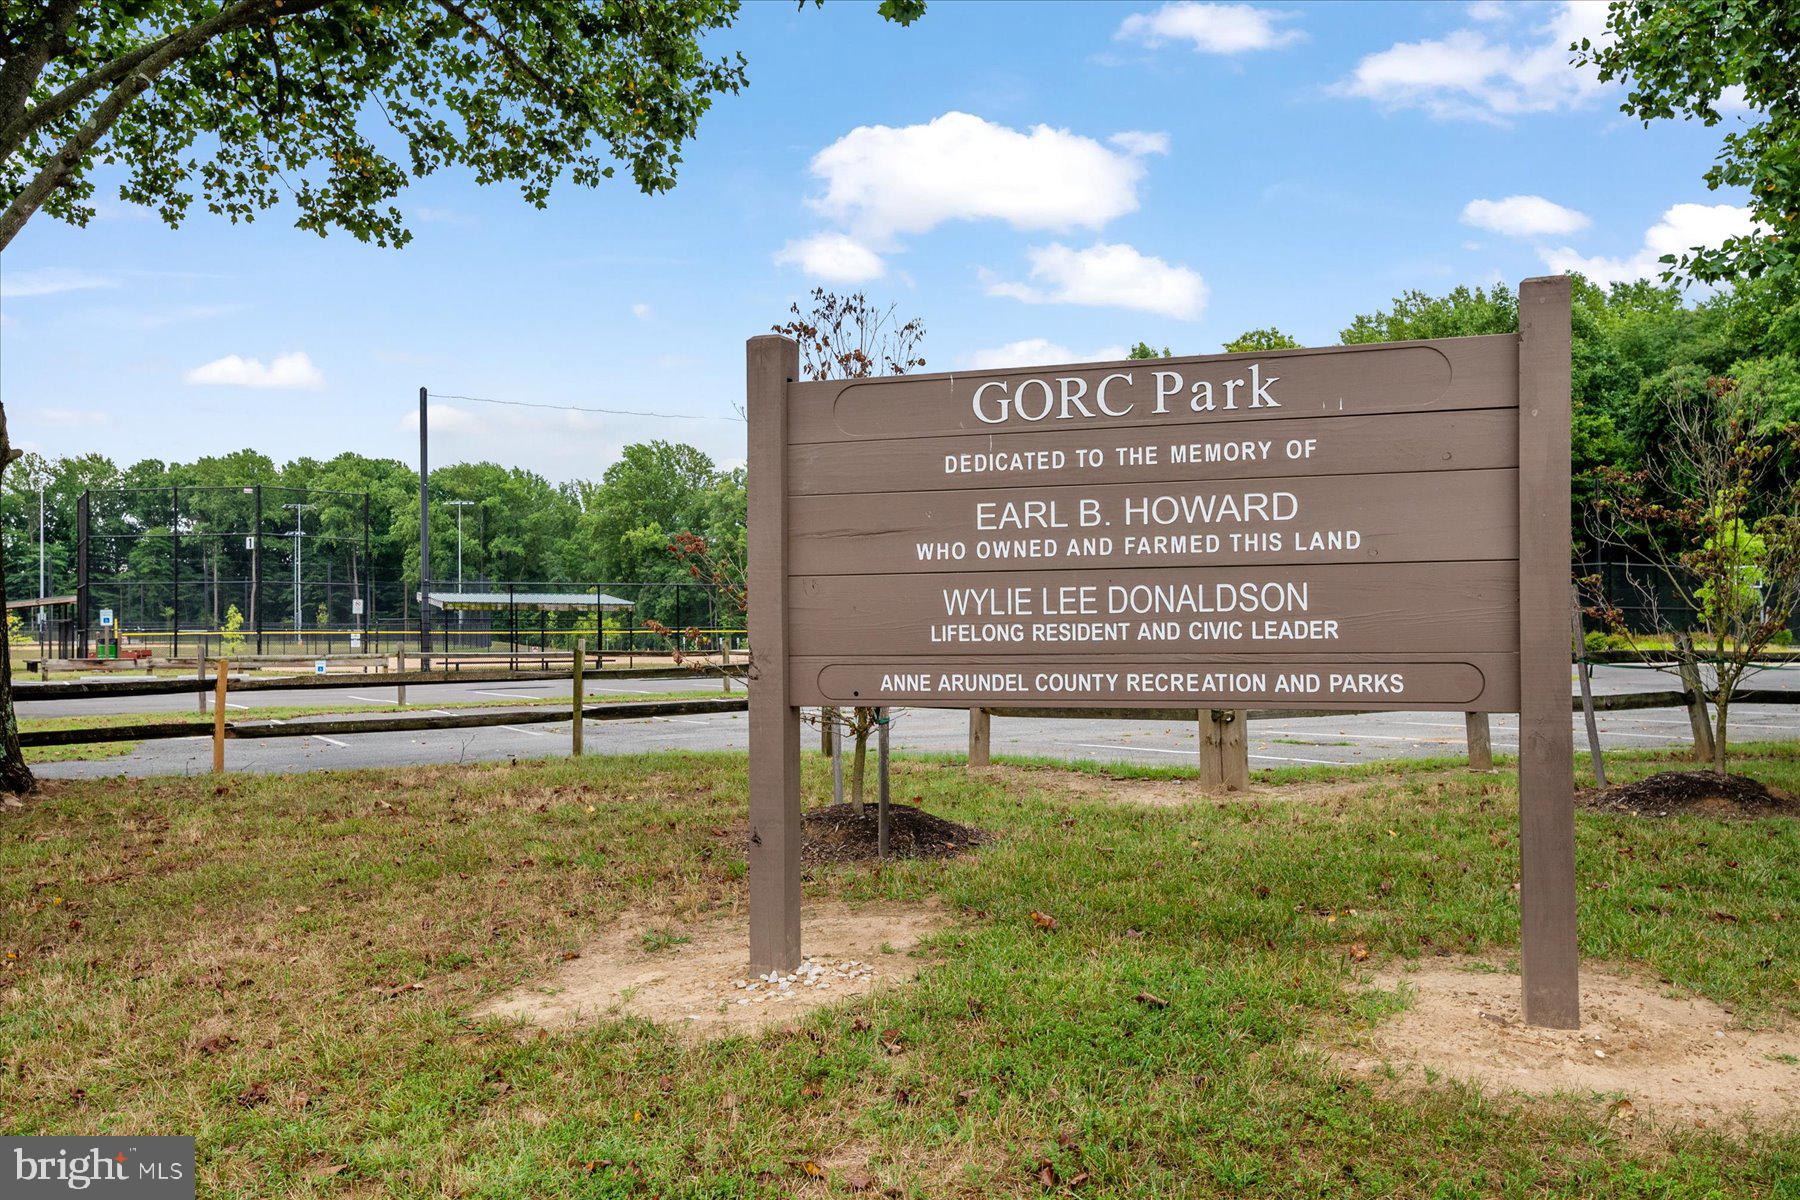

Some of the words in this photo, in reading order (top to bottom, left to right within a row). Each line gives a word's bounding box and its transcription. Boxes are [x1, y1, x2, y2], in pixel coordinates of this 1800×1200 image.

[972, 372, 1134, 424] GORC
[1151, 363, 1282, 414] Park
[944, 451, 1066, 474] DEDICATED
[1075, 449, 1104, 468] TO
[1115, 446, 1158, 466] THE
[1170, 441, 1272, 464] MEMORY
[1285, 438, 1317, 460] OF
[976, 500, 1069, 531] EARL
[1079, 498, 1110, 527] B.
[1125, 491, 1299, 526] HOWARD
[915, 541, 966, 561] WHO
[976, 538, 1058, 560] OWNED
[1066, 537, 1113, 557] AND
[1124, 534, 1220, 555] FARMED
[1229, 532, 1283, 553] THIS
[1294, 529, 1361, 551] LAND
[942, 587, 1033, 616] WYLIE
[1042, 586, 1098, 615] LEE
[1108, 581, 1308, 614] DONALDSON
[931, 623, 1025, 642] LIFELONG
[1032, 622, 1131, 642] RESIDENT
[1136, 621, 1181, 641] AND
[1188, 621, 1243, 641] CIVIC
[1251, 619, 1339, 640] LEADER
[880, 673, 932, 692] ANNE
[937, 673, 1029, 692] ARUNDEL
[1035, 673, 1119, 692] COUNTY
[1126, 673, 1266, 693] RECREATION
[1274, 673, 1321, 693] AND
[1329, 673, 1405, 694] PARKS
